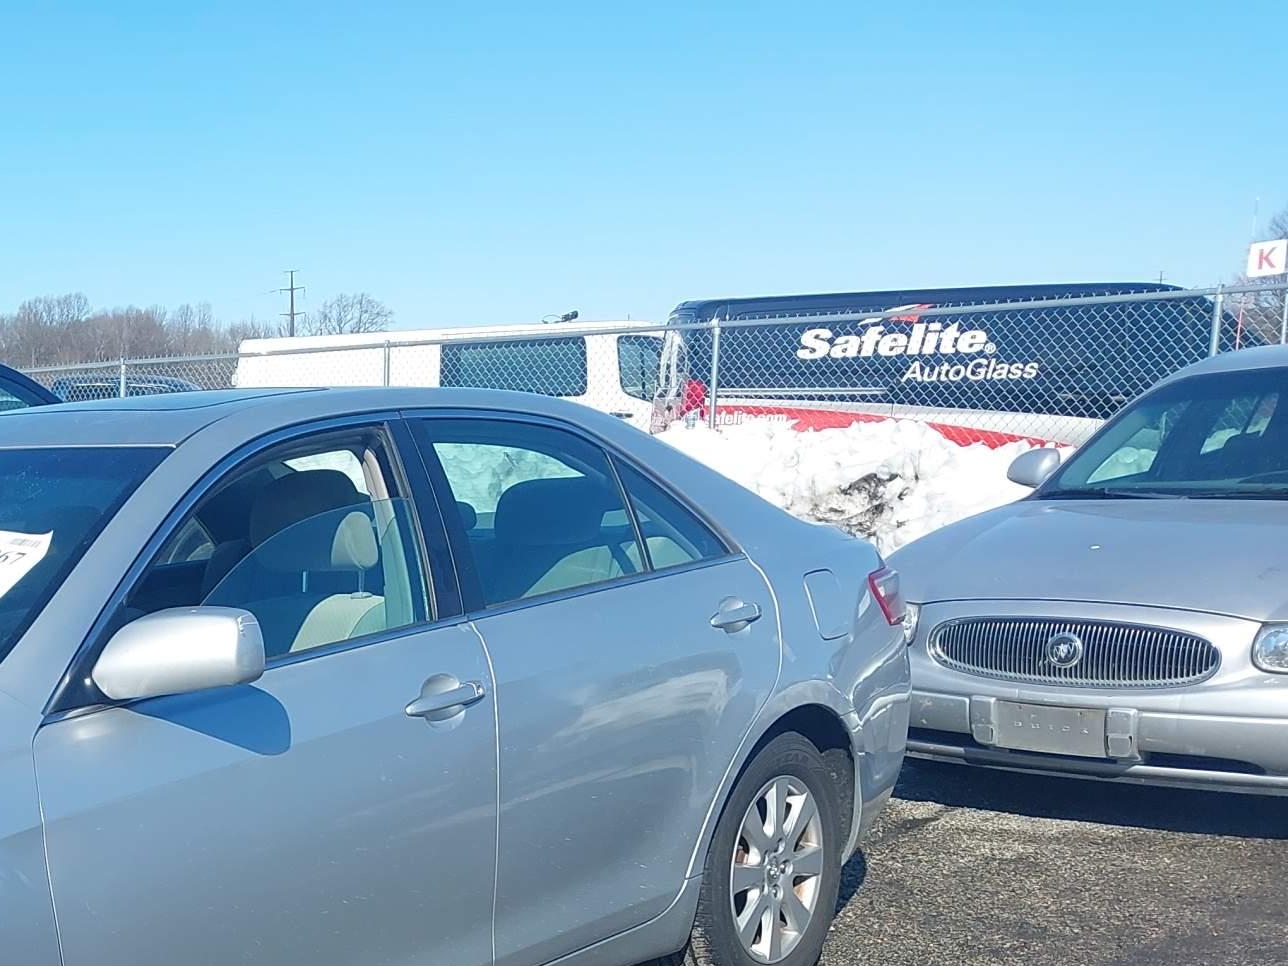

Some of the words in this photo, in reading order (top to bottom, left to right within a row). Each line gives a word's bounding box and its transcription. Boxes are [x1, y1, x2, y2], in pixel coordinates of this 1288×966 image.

[1257, 247, 1277, 270] K
[796, 321, 988, 360] Safelite
[900, 358, 1039, 383] AutoGlass
